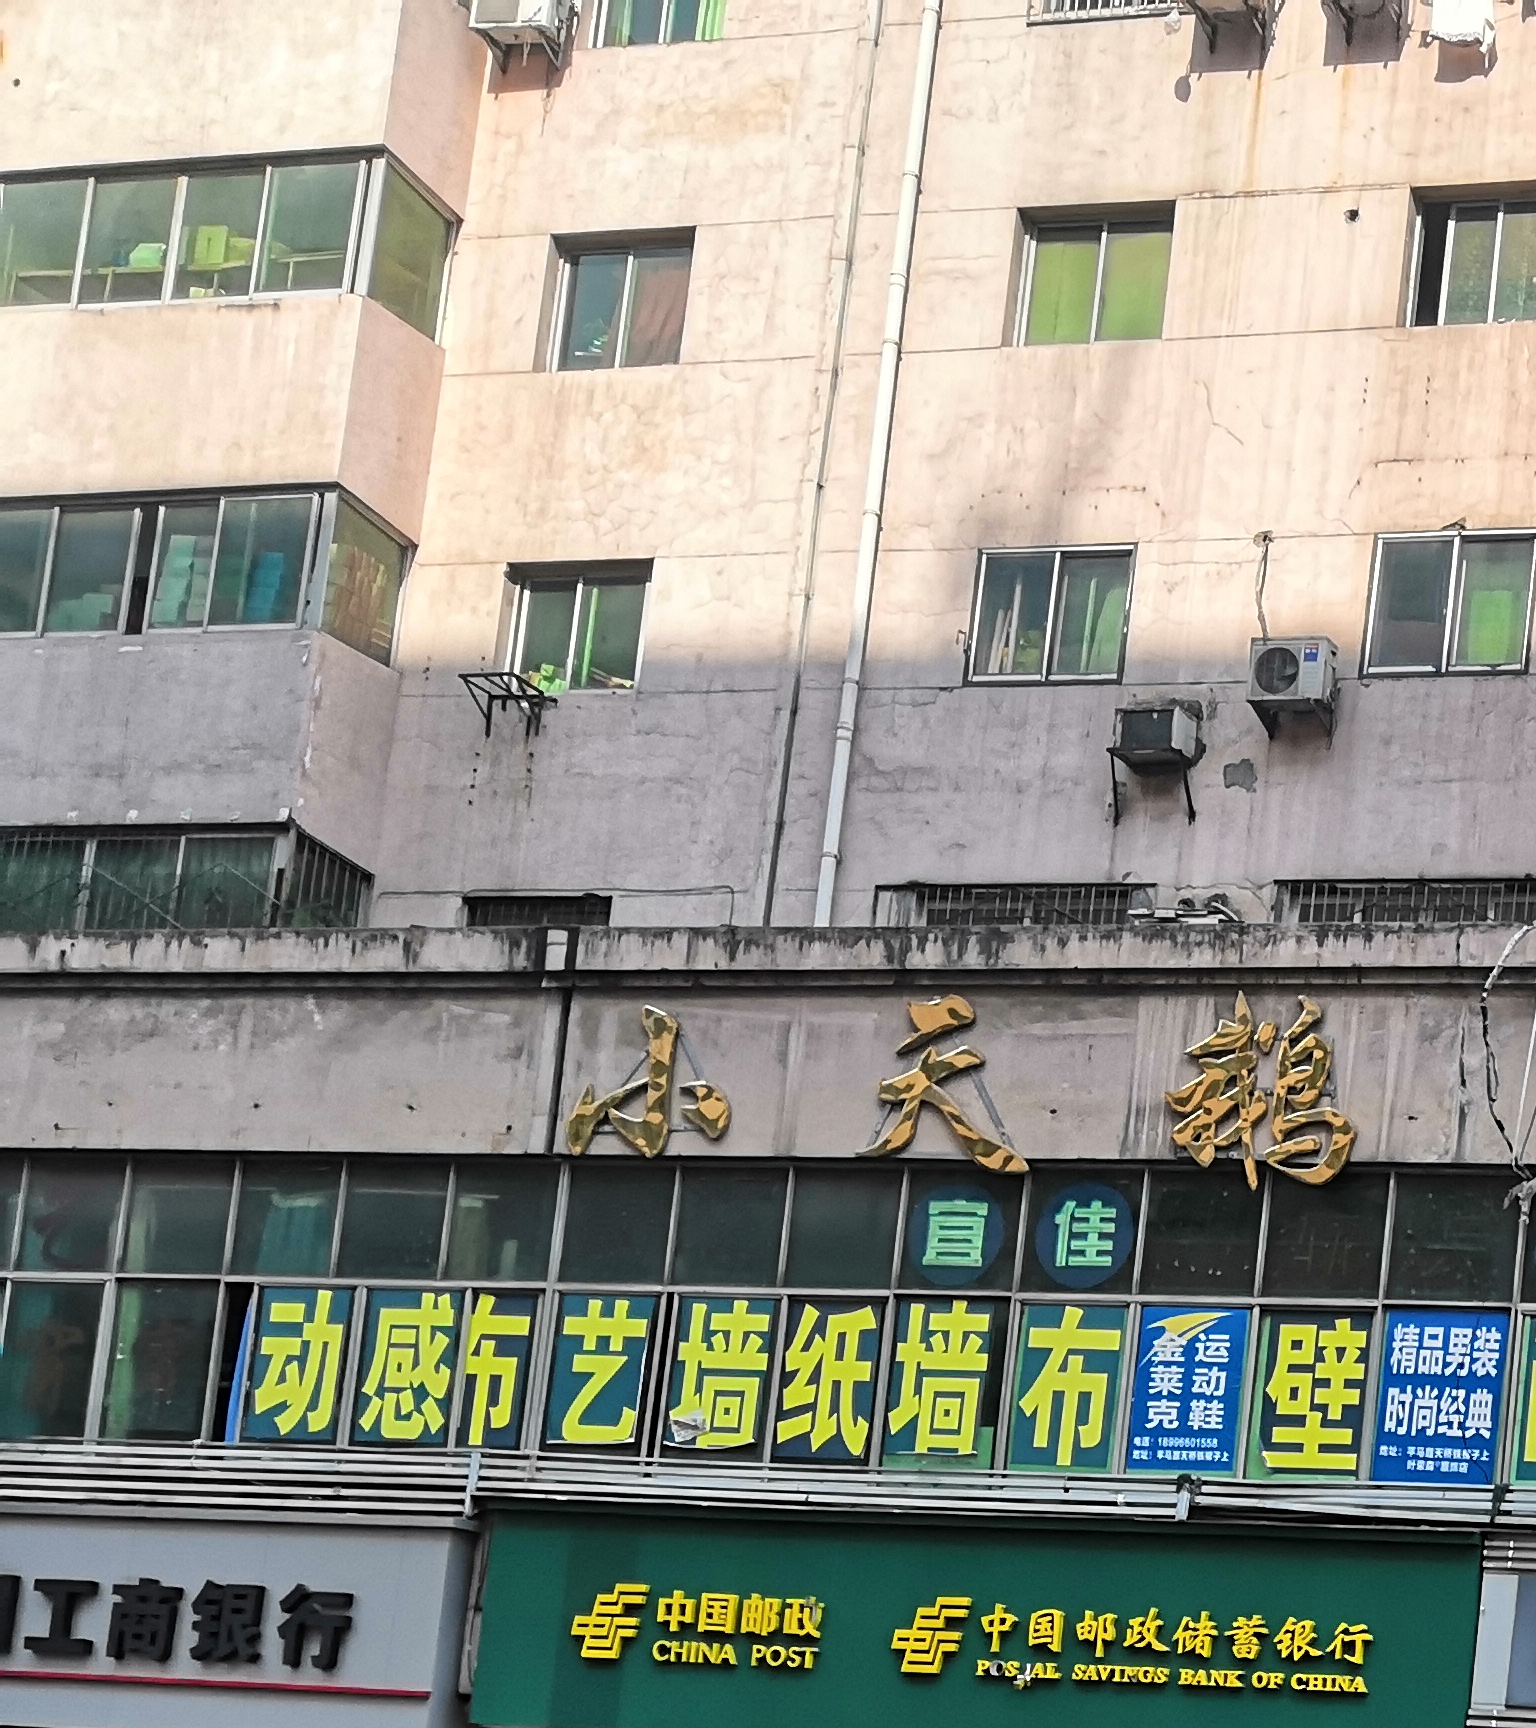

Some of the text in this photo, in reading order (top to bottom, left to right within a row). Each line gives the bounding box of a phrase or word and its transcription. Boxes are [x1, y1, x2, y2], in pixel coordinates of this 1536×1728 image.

[253, 1288, 1121, 1467] 动感布艺墙纸墙布
[1390, 1323, 1502, 1378] 精品男装
[1384, 1385, 1494, 1440] 时尚经典
[656, 1589, 826, 1639] 中国邮政
[980, 1602, 1374, 1666] 中国邮政储蓄银行
[652, 1639, 820, 1670] CHINA POST
[1071, 1664, 1170, 1684] SAVINGS
[1178, 1667, 1246, 1688] BANK
[1251, 1672, 1286, 1689] OF
[1289, 1673, 1370, 1694] CHINA
